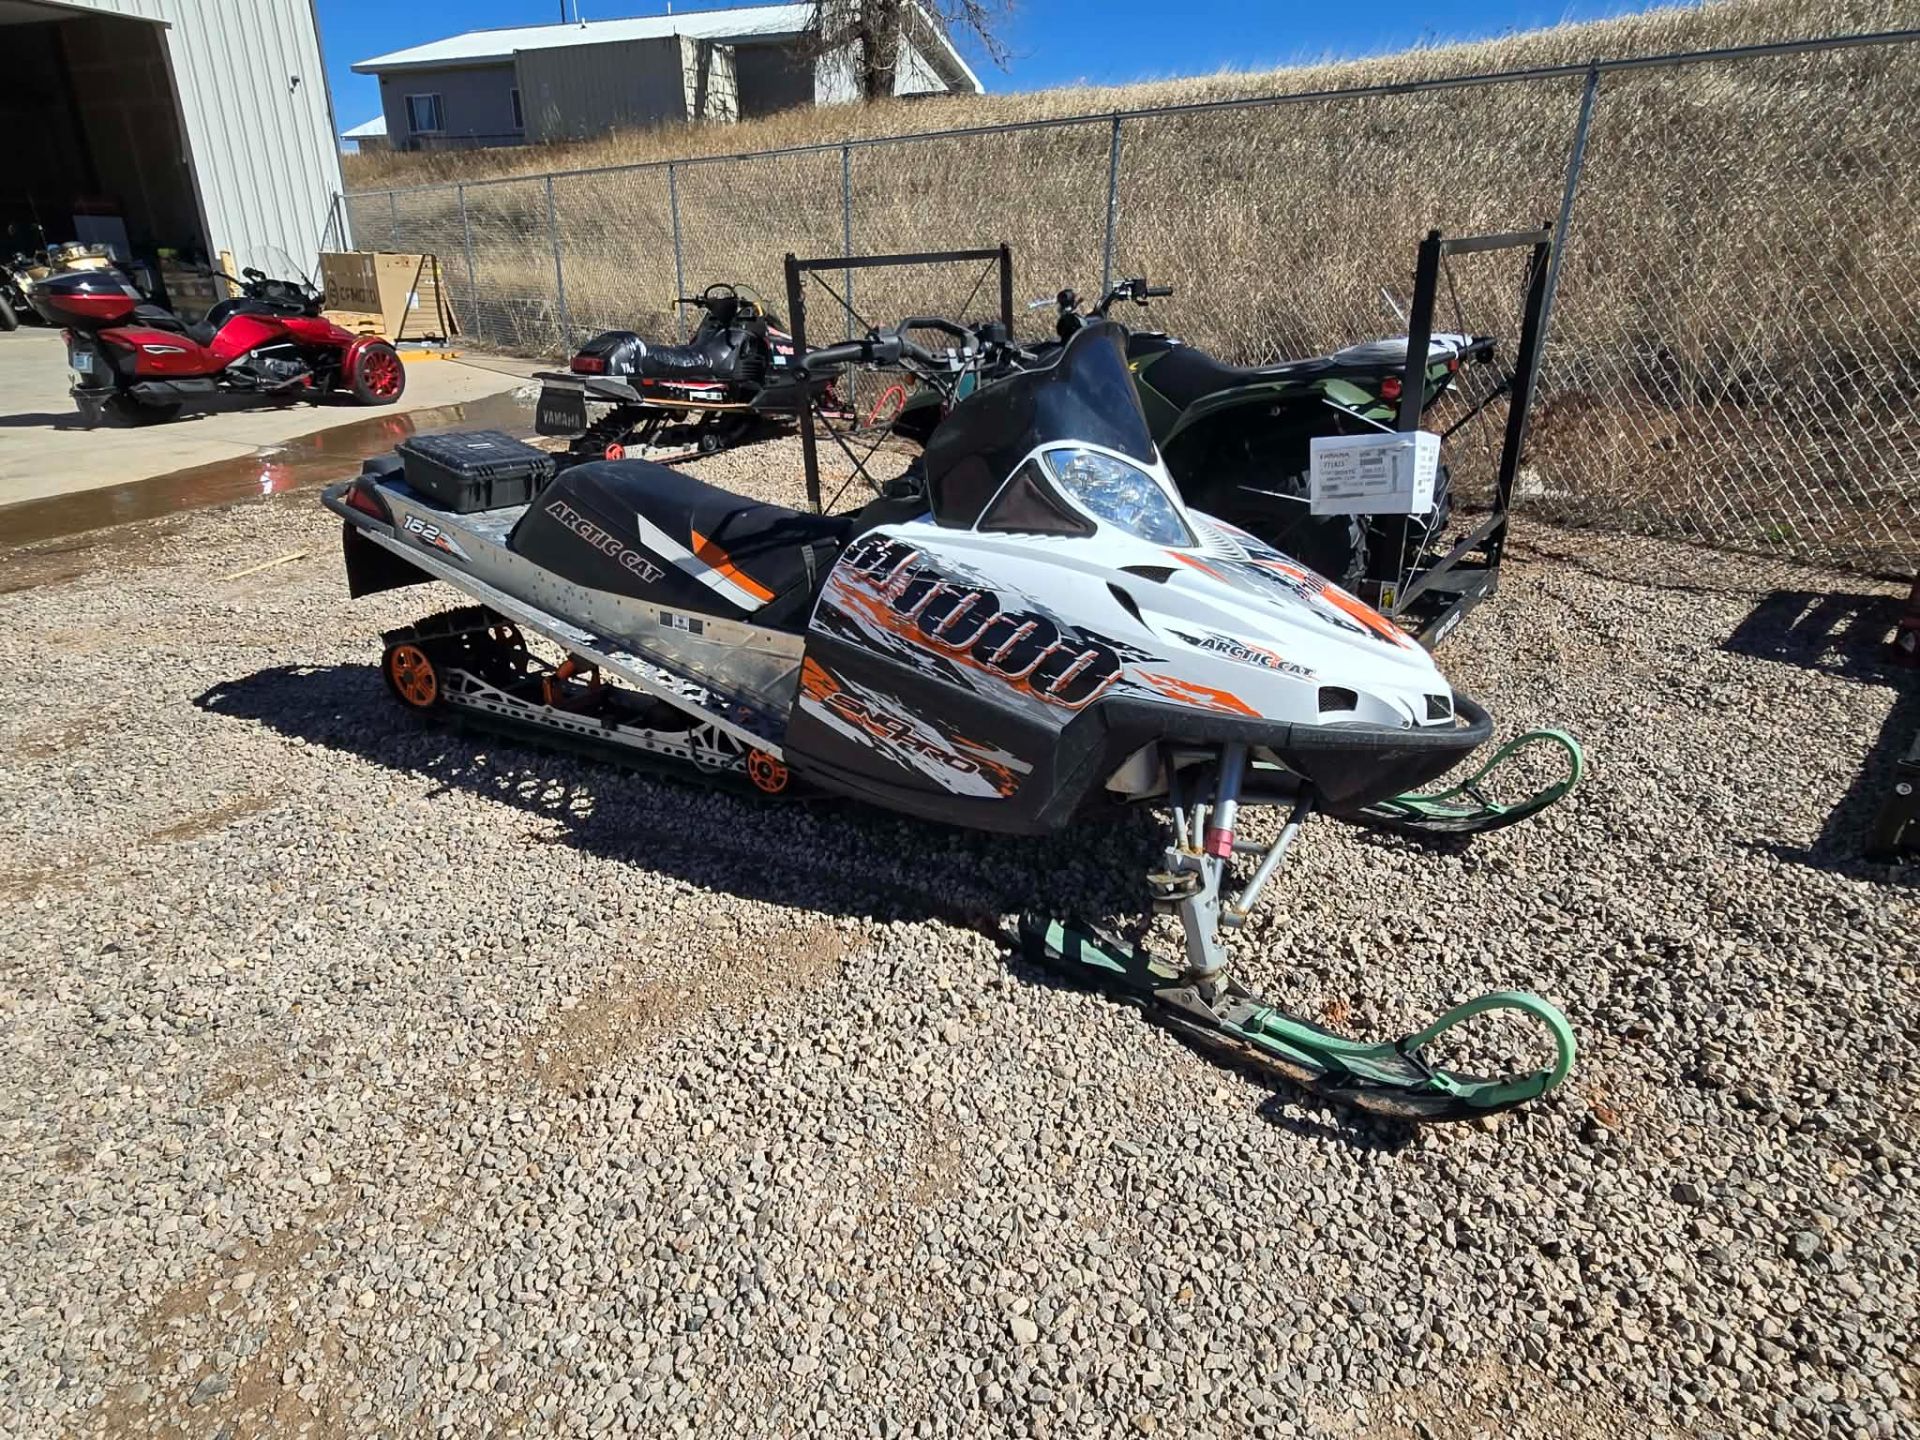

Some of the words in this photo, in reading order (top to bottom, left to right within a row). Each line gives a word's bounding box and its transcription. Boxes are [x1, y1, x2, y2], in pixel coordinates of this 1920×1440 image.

[340, 286, 377, 304] CFMOTO
[543, 409, 580, 428] YAMAHA
[404, 514, 440, 541] 162
[545, 500, 623, 557] ARCTIC
[619, 550, 666, 583] CAT
[1200, 638, 1273, 667] ARCTIC
[1277, 662, 1316, 676] CAT
